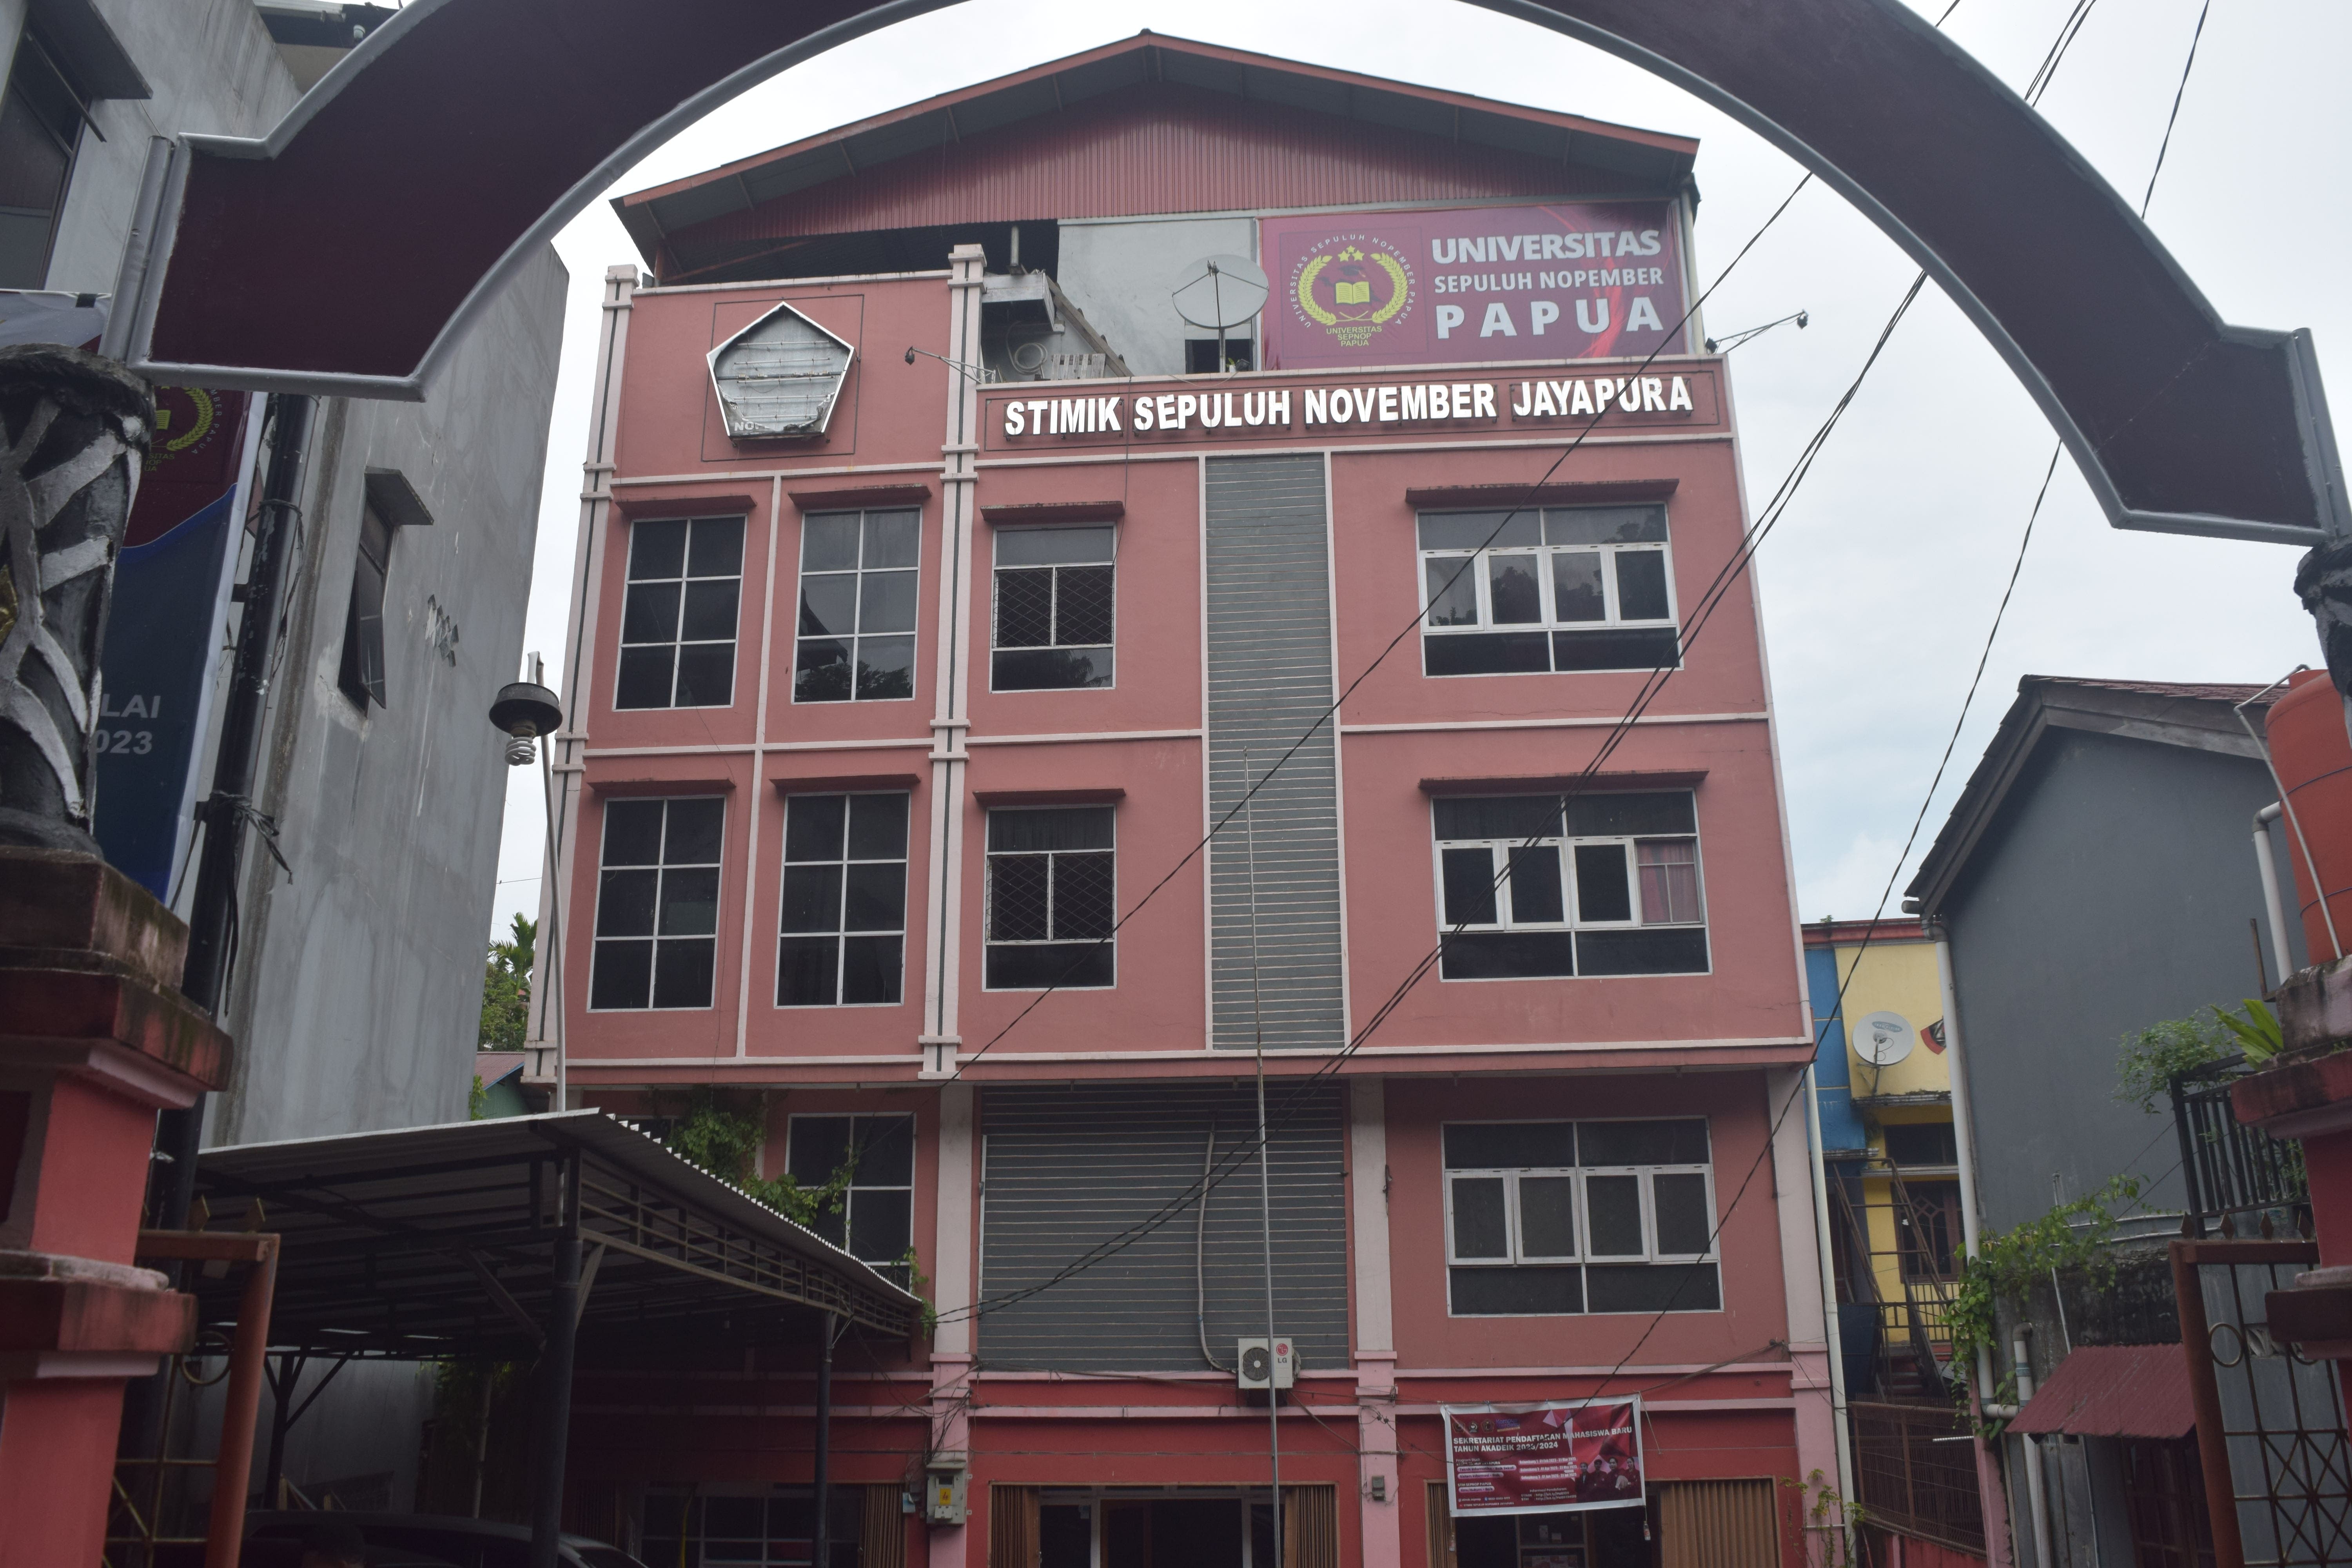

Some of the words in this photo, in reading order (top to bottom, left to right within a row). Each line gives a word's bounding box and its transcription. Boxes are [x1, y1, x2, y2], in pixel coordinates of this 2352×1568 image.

[1432, 230, 1661, 264] UNIVERSITAS
[1290, 256, 1312, 328] UNIVERSITAS
[1310, 234, 1365, 253] SEPULUH
[1372, 237, 1415, 285] NOPEMBER
[1395, 292, 1416, 325] PAPUA
[1435, 272, 1532, 293] SEPULUH
[1540, 267, 1664, 289] NOPEMBER
[1326, 326, 1382, 334] UNIVERSITAS
[210, 389, 222, 416] MBER
[1005, 397, 1124, 435] STIMIK
[1134, 390, 1290, 431] SEPULUH
[1305, 383, 1497, 424] NOVEMBER
[1514, 376, 1693, 416] JAYAPURA
[191, 423, 220, 454] PAPUA
[100, 693, 161, 718] LAI
[95, 729, 152, 755] 023
[1506, 1434, 1560, 1443] PENDAFTARAN
[1563, 1430, 1610, 1439] MAHASISWA
[1611, 1426, 1632, 1435] BARU
[1516, 1441, 1558, 1451] 2023/2024
